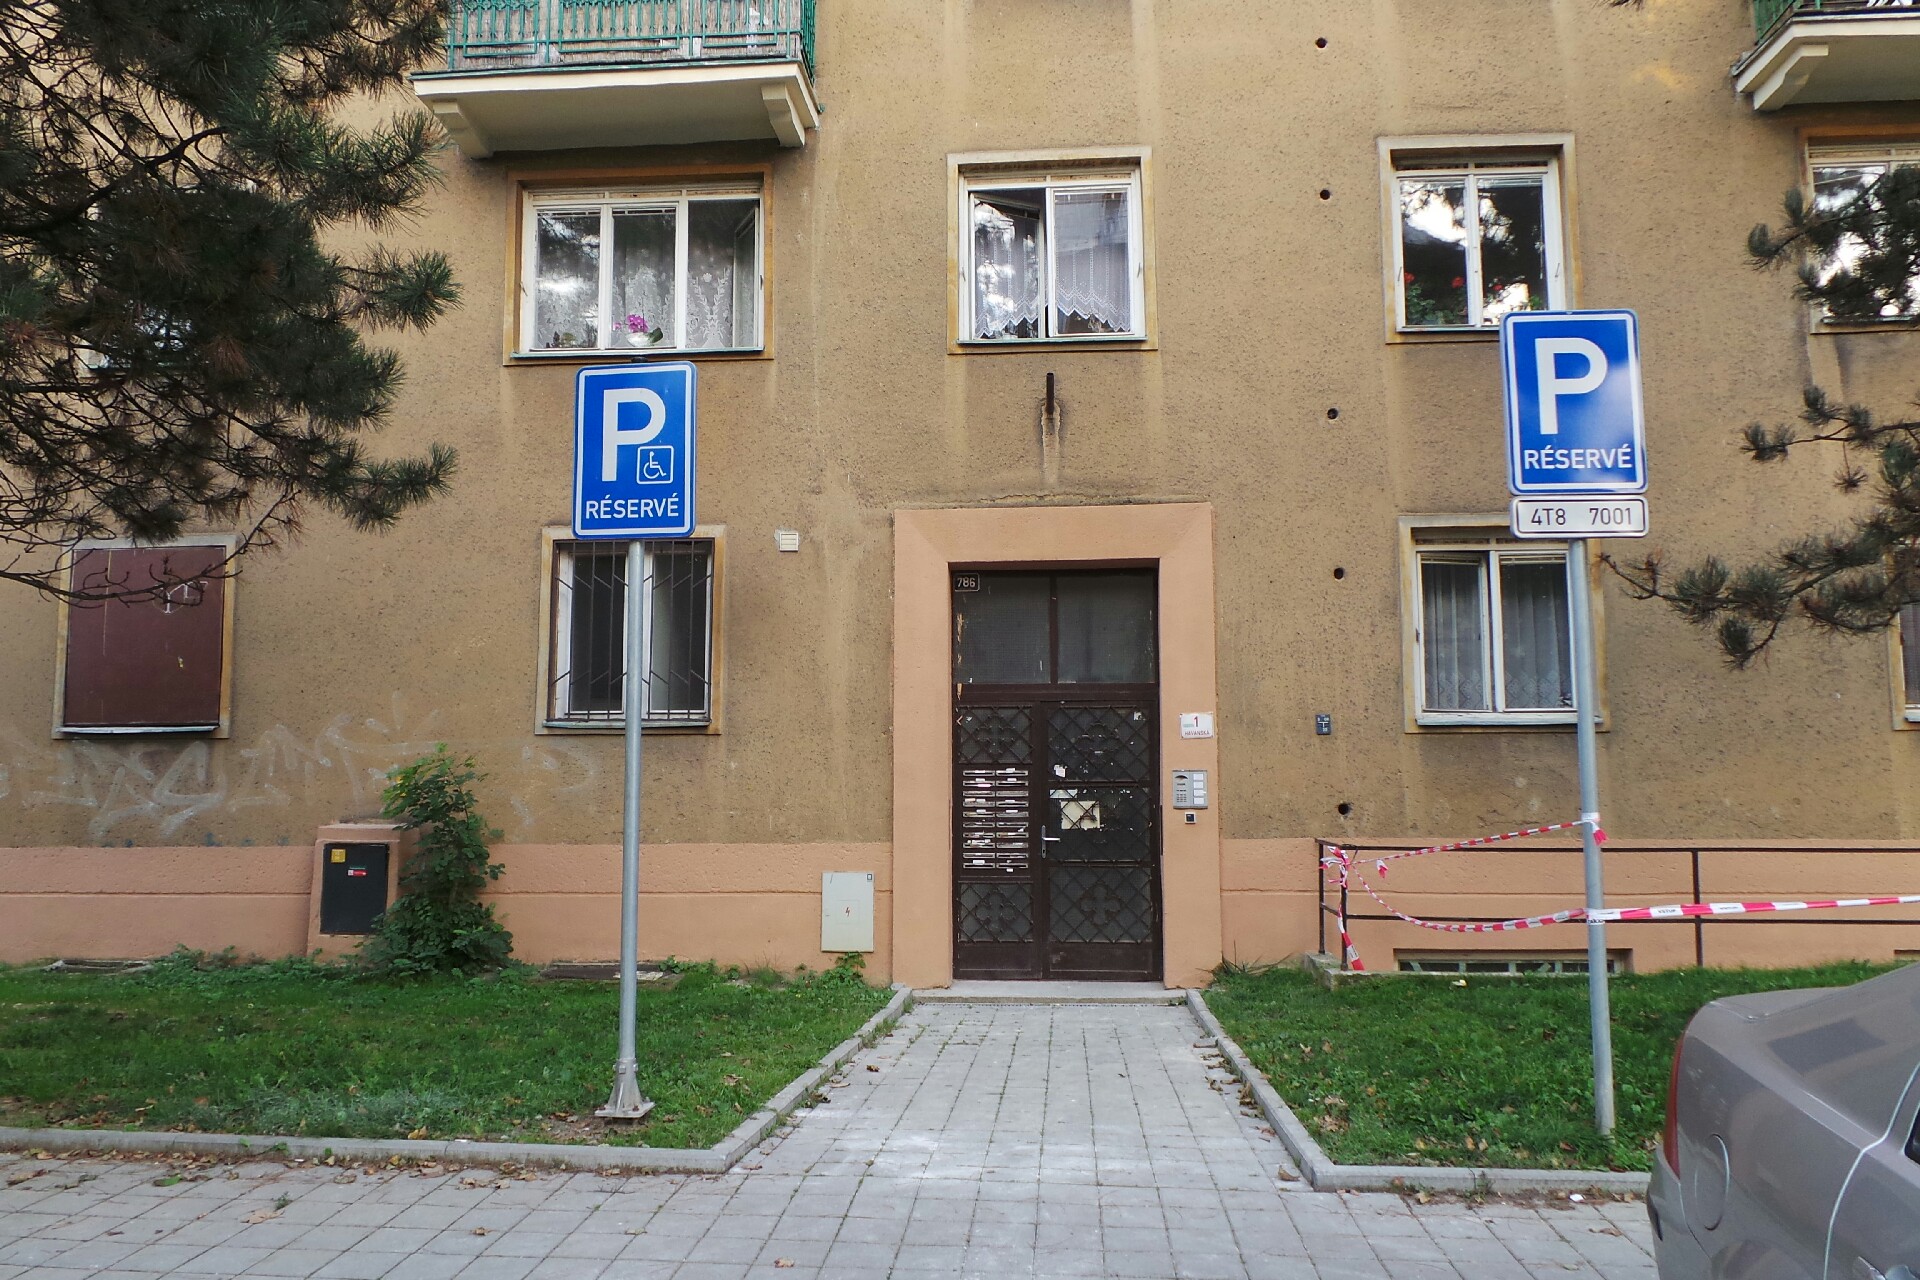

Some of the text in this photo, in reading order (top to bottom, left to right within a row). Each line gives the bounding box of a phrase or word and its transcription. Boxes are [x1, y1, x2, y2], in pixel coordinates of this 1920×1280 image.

[1534, 337, 1608, 435] P
[601, 387, 666, 482] P
[1524, 443, 1633, 469] RÉSERVÉ
[585, 492, 679, 519] RÉSERVÉ
[1531, 507, 1632, 526] 4T8 7001
[957, 577, 976, 588] 786
[1193, 716, 1199, 728] 1
